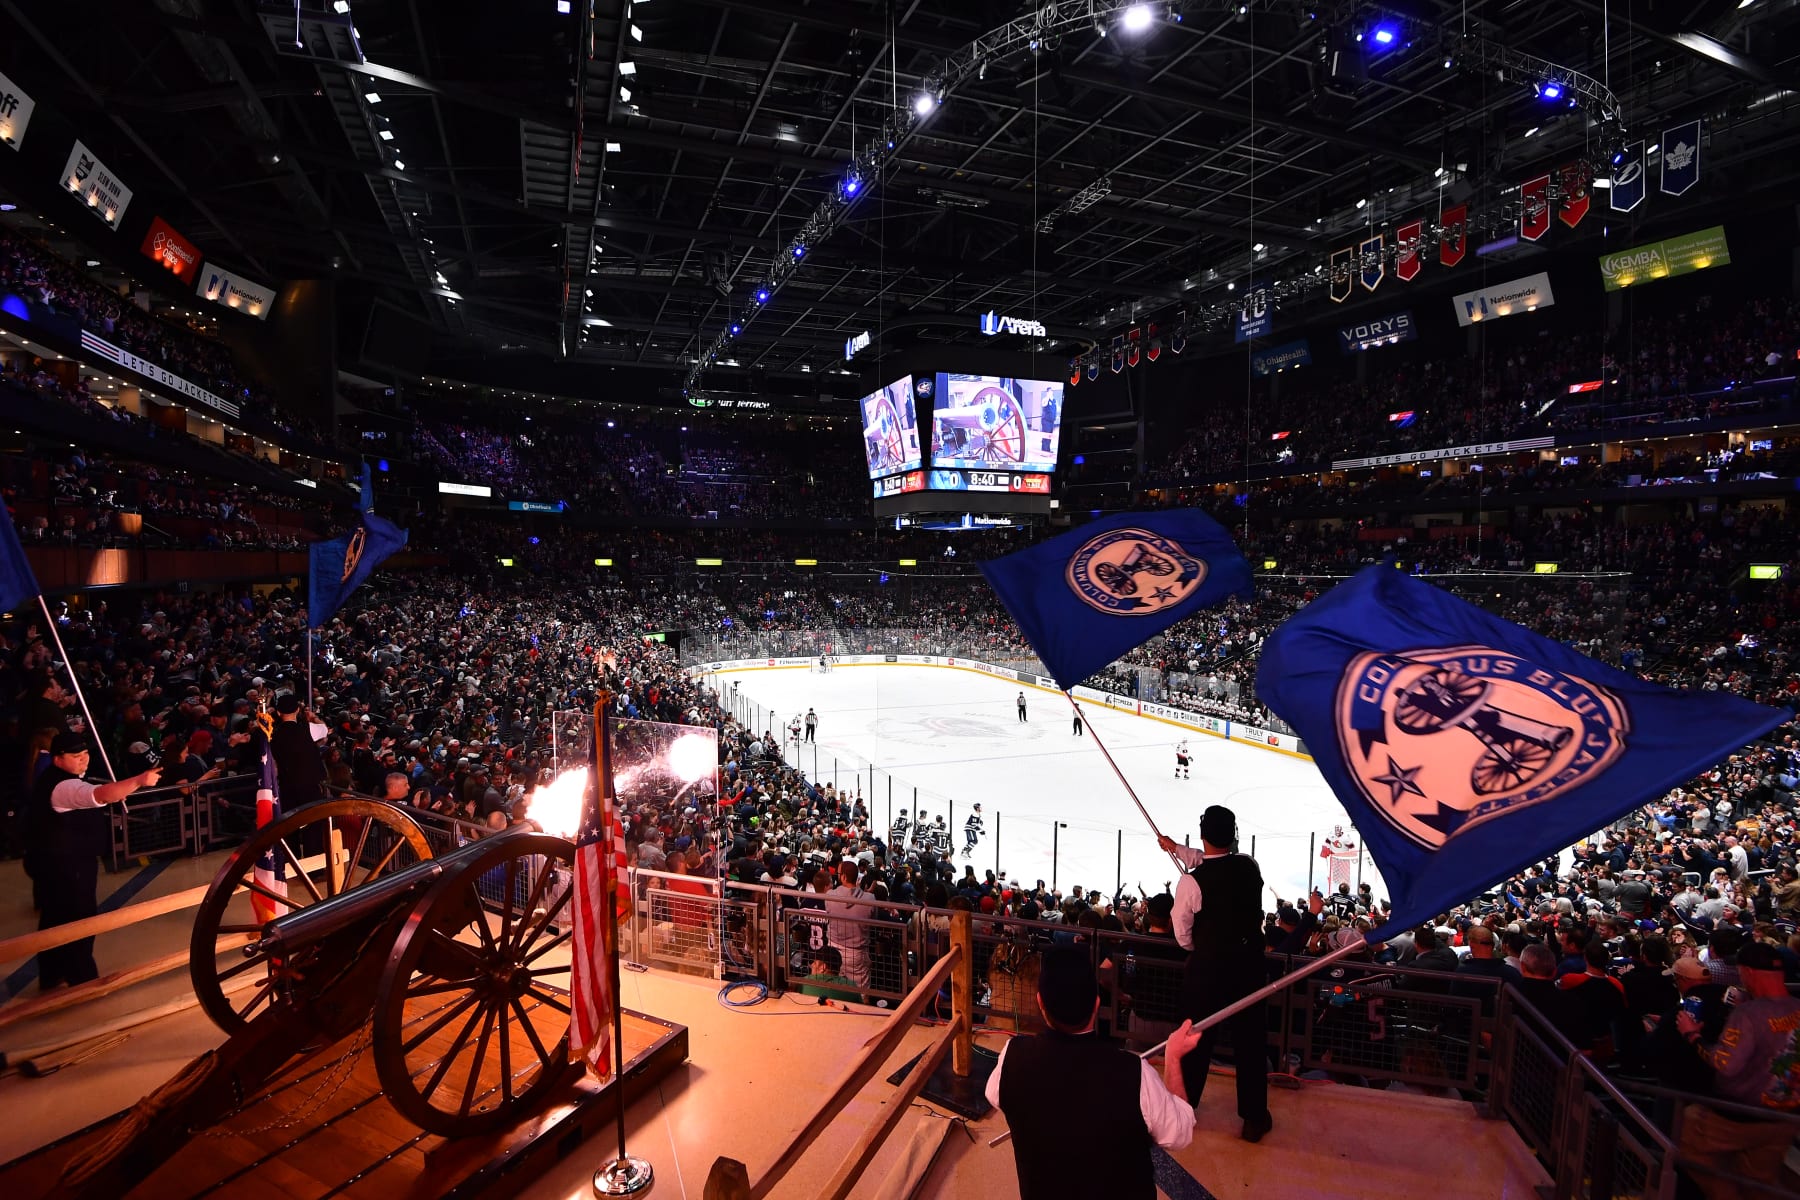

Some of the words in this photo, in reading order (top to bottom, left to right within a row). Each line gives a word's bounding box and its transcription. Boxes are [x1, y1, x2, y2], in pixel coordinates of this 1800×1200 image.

[0, 91, 19, 118] ff
[163, 248, 178, 265] Office
[167, 239, 195, 264] Continental
[1610, 249, 1661, 271] KEMBA
[229, 285, 263, 305] Nationwide
[1490, 287, 1537, 306] Nationwide
[997, 316, 1046, 337] Arena
[1341, 314, 1409, 341] VORYS
[1266, 349, 1307, 366] OhioHealth
[123, 353, 155, 377] LET'S
[161, 371, 174, 386] GO
[178, 380, 219, 407] JACKETS
[1367, 455, 1401, 465] LET'S
[1410, 452, 1426, 460] GO
[1434, 443, 1504, 458] JACKETS
[950, 474, 959, 487] 0
[970, 473, 995, 487] 8:40
[1013, 476, 1022, 490] 0
[974, 517, 1011, 526] Nationwide
[1359, 656, 1518, 704] COLBUS
[1245, 727, 1264, 737] TRULY
[939, 835, 947, 848] 17
[1334, 904, 1348, 917] 17
[809, 924, 824, 951] 8
[1367, 999, 1386, 1041] 5
